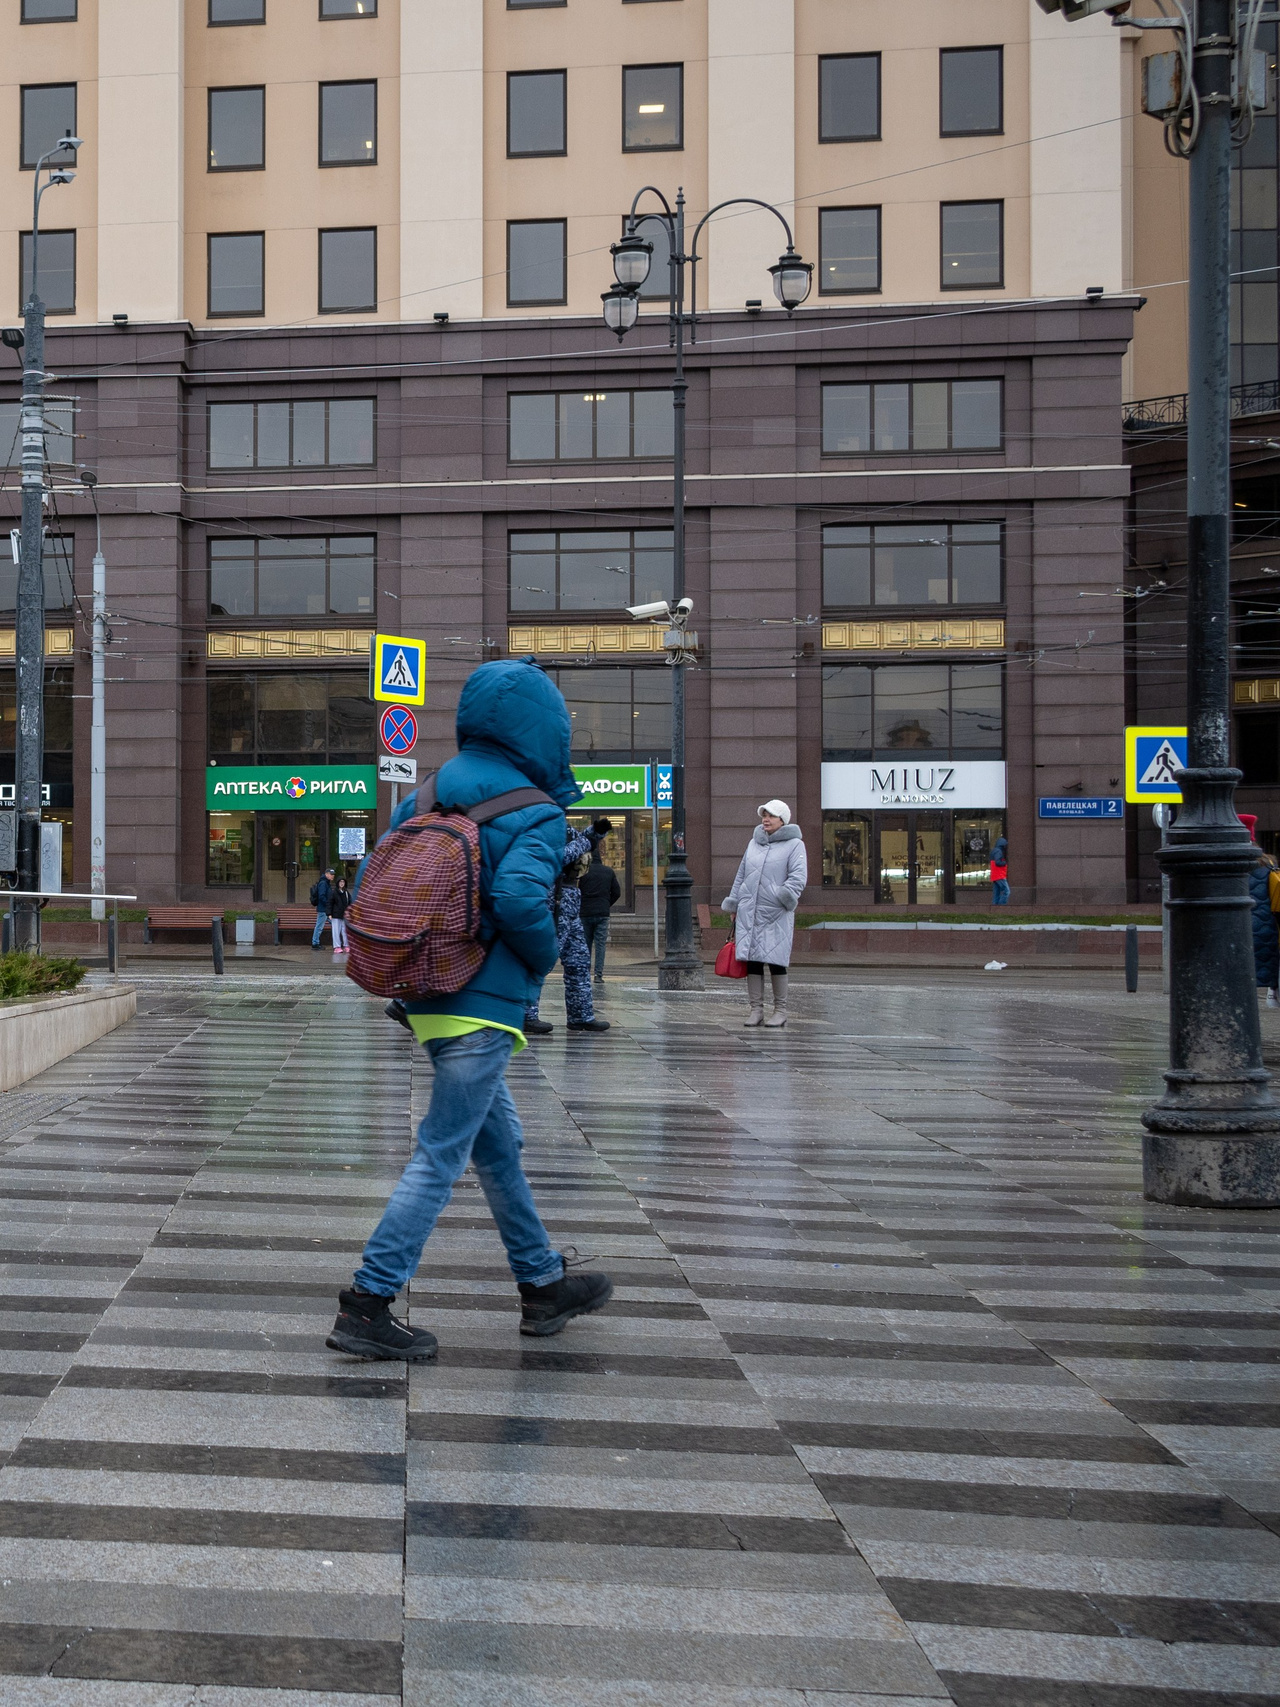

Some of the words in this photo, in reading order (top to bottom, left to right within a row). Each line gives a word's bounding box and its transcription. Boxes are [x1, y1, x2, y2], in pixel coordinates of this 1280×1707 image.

[575, 779, 639, 793] АФОН
[870, 768, 955, 791] MIUZ
[213, 781, 283, 795] АПТЕКА
[310, 780, 367, 794] РИГЛА
[881, 794, 945, 803] DIAMONDS
[1108, 801, 1116, 812] 2
